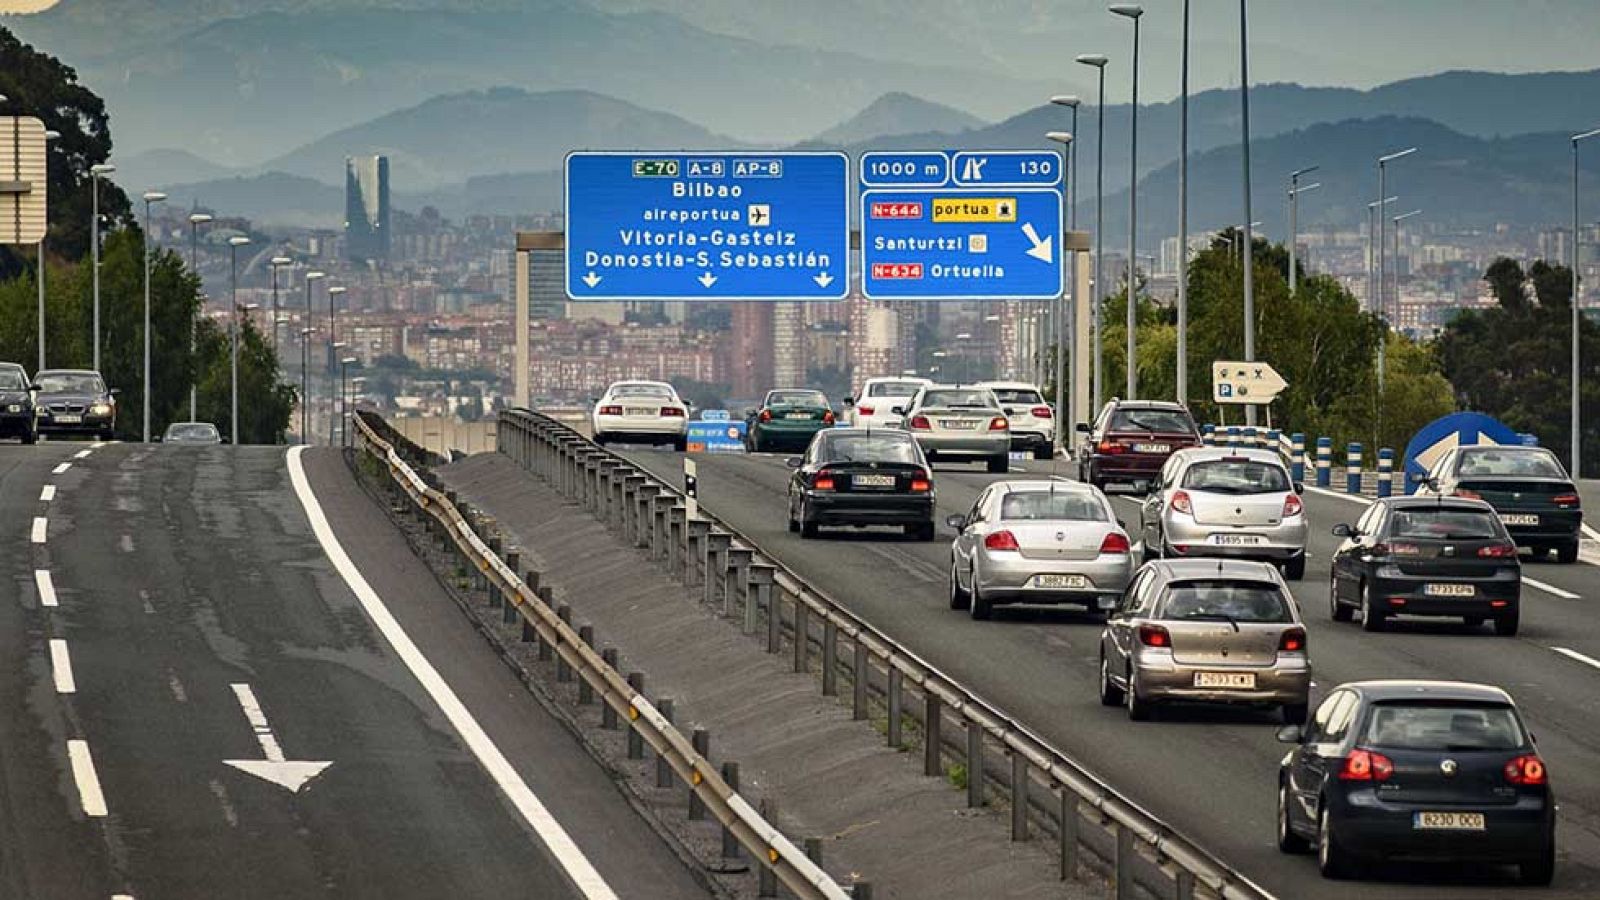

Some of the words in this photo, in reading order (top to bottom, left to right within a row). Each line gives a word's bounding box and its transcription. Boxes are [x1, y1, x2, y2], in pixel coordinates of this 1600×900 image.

[634, 162, 677, 175] E-70
[690, 162, 722, 175] A-8
[735, 162, 780, 175] AP-8
[871, 162, 915, 176] 1000
[925, 165, 938, 175] m
[1020, 161, 1051, 175] 130
[673, 182, 742, 197] Bilbao
[644, 208, 740, 223] aireportua
[872, 205, 920, 216] N-644
[935, 202, 989, 217] portua
[620, 230, 796, 246] Vitoria-Gasteiz
[874, 236, 963, 250] Santurtzi
[585, 251, 714, 267] Donostia-S.
[720, 251, 830, 267] Sebastián
[874, 265, 921, 277] N-634
[931, 264, 1004, 278] Ortuella
[1424, 814, 1454, 825] 8230
